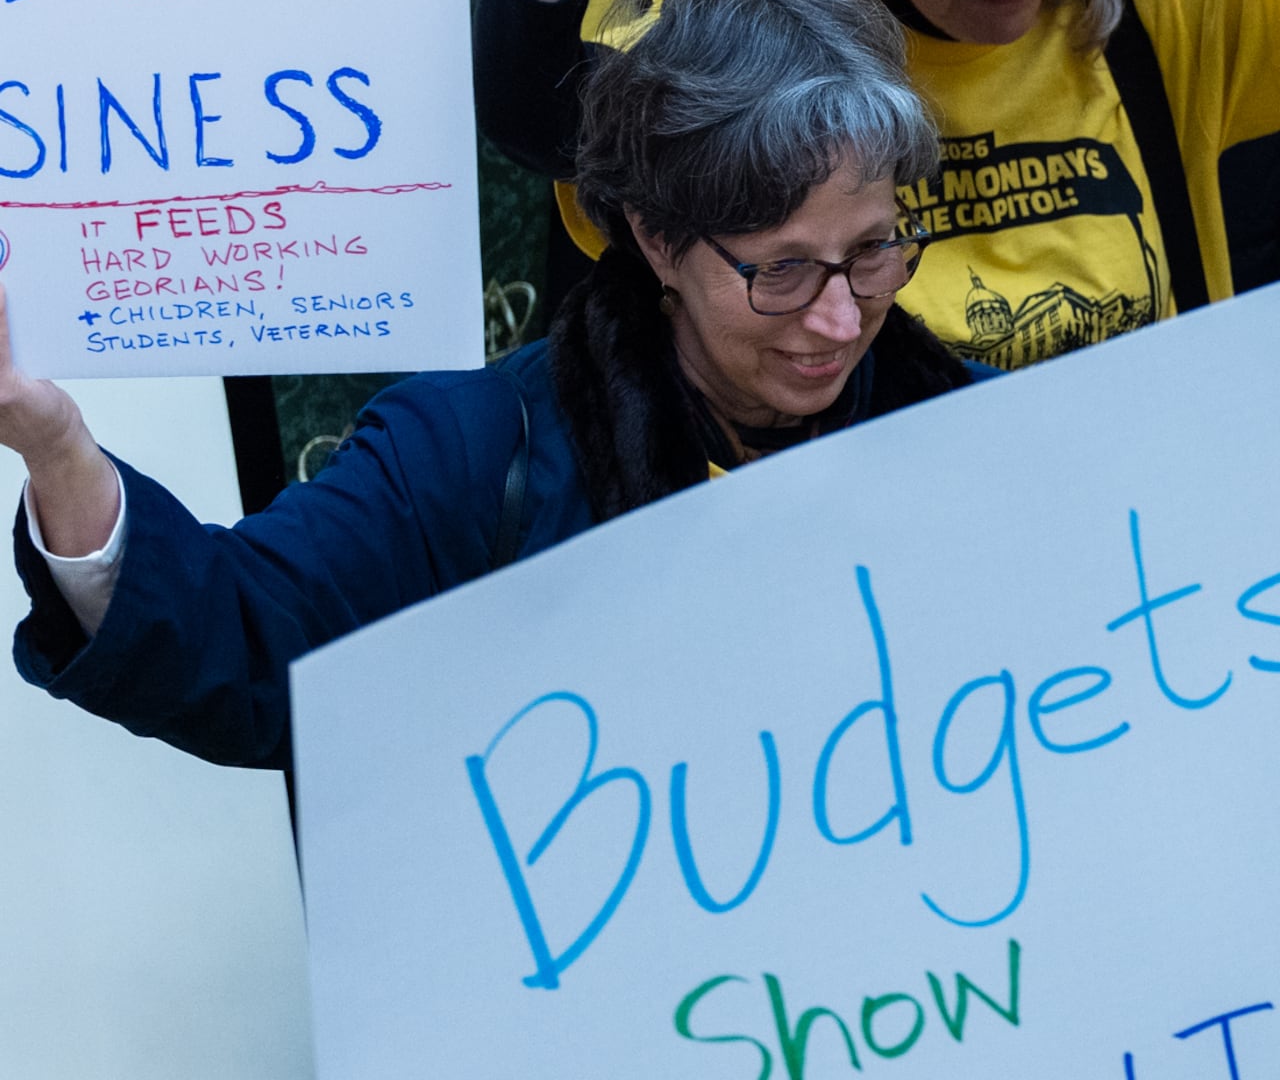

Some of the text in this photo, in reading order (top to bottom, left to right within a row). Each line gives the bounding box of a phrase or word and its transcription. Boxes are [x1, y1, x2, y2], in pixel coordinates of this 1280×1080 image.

[0, 67, 382, 179] SINESS
[943, 147, 1109, 202] MONDAYS
[81, 201, 287, 240] IT FEEDS
[955, 186, 1080, 228] CAPITOL:
[81, 235, 369, 275] HARD WORKING
[86, 266, 285, 302] GEORIANS!
[291, 291, 415, 314] SENIORS
[252, 320, 392, 344] VETERANS
